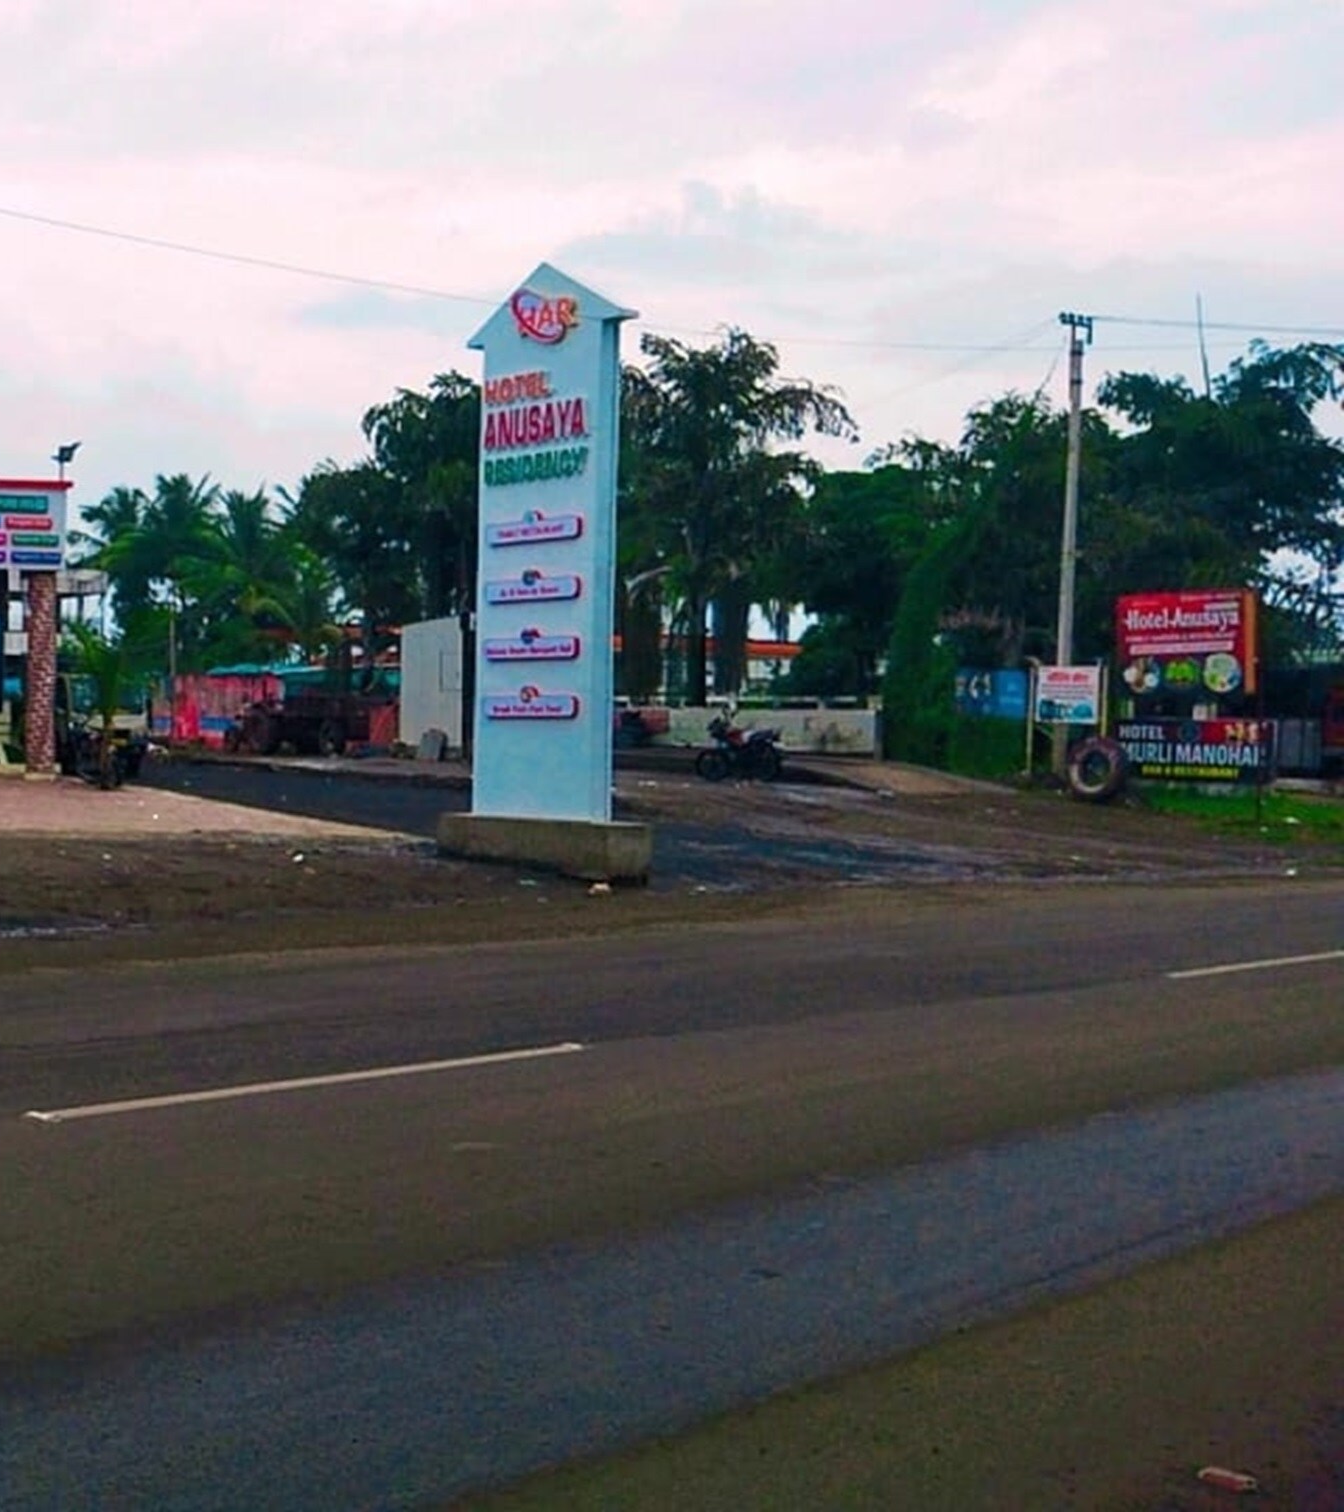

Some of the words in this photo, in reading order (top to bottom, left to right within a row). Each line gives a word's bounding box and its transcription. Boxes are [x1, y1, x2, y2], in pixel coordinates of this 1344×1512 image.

[485, 371, 549, 404] HOTEL
[485, 398, 586, 449] ANUSAYA
[484, 446, 588, 486] RESIDENCY
[1119, 725, 1164, 740] HOTEL
